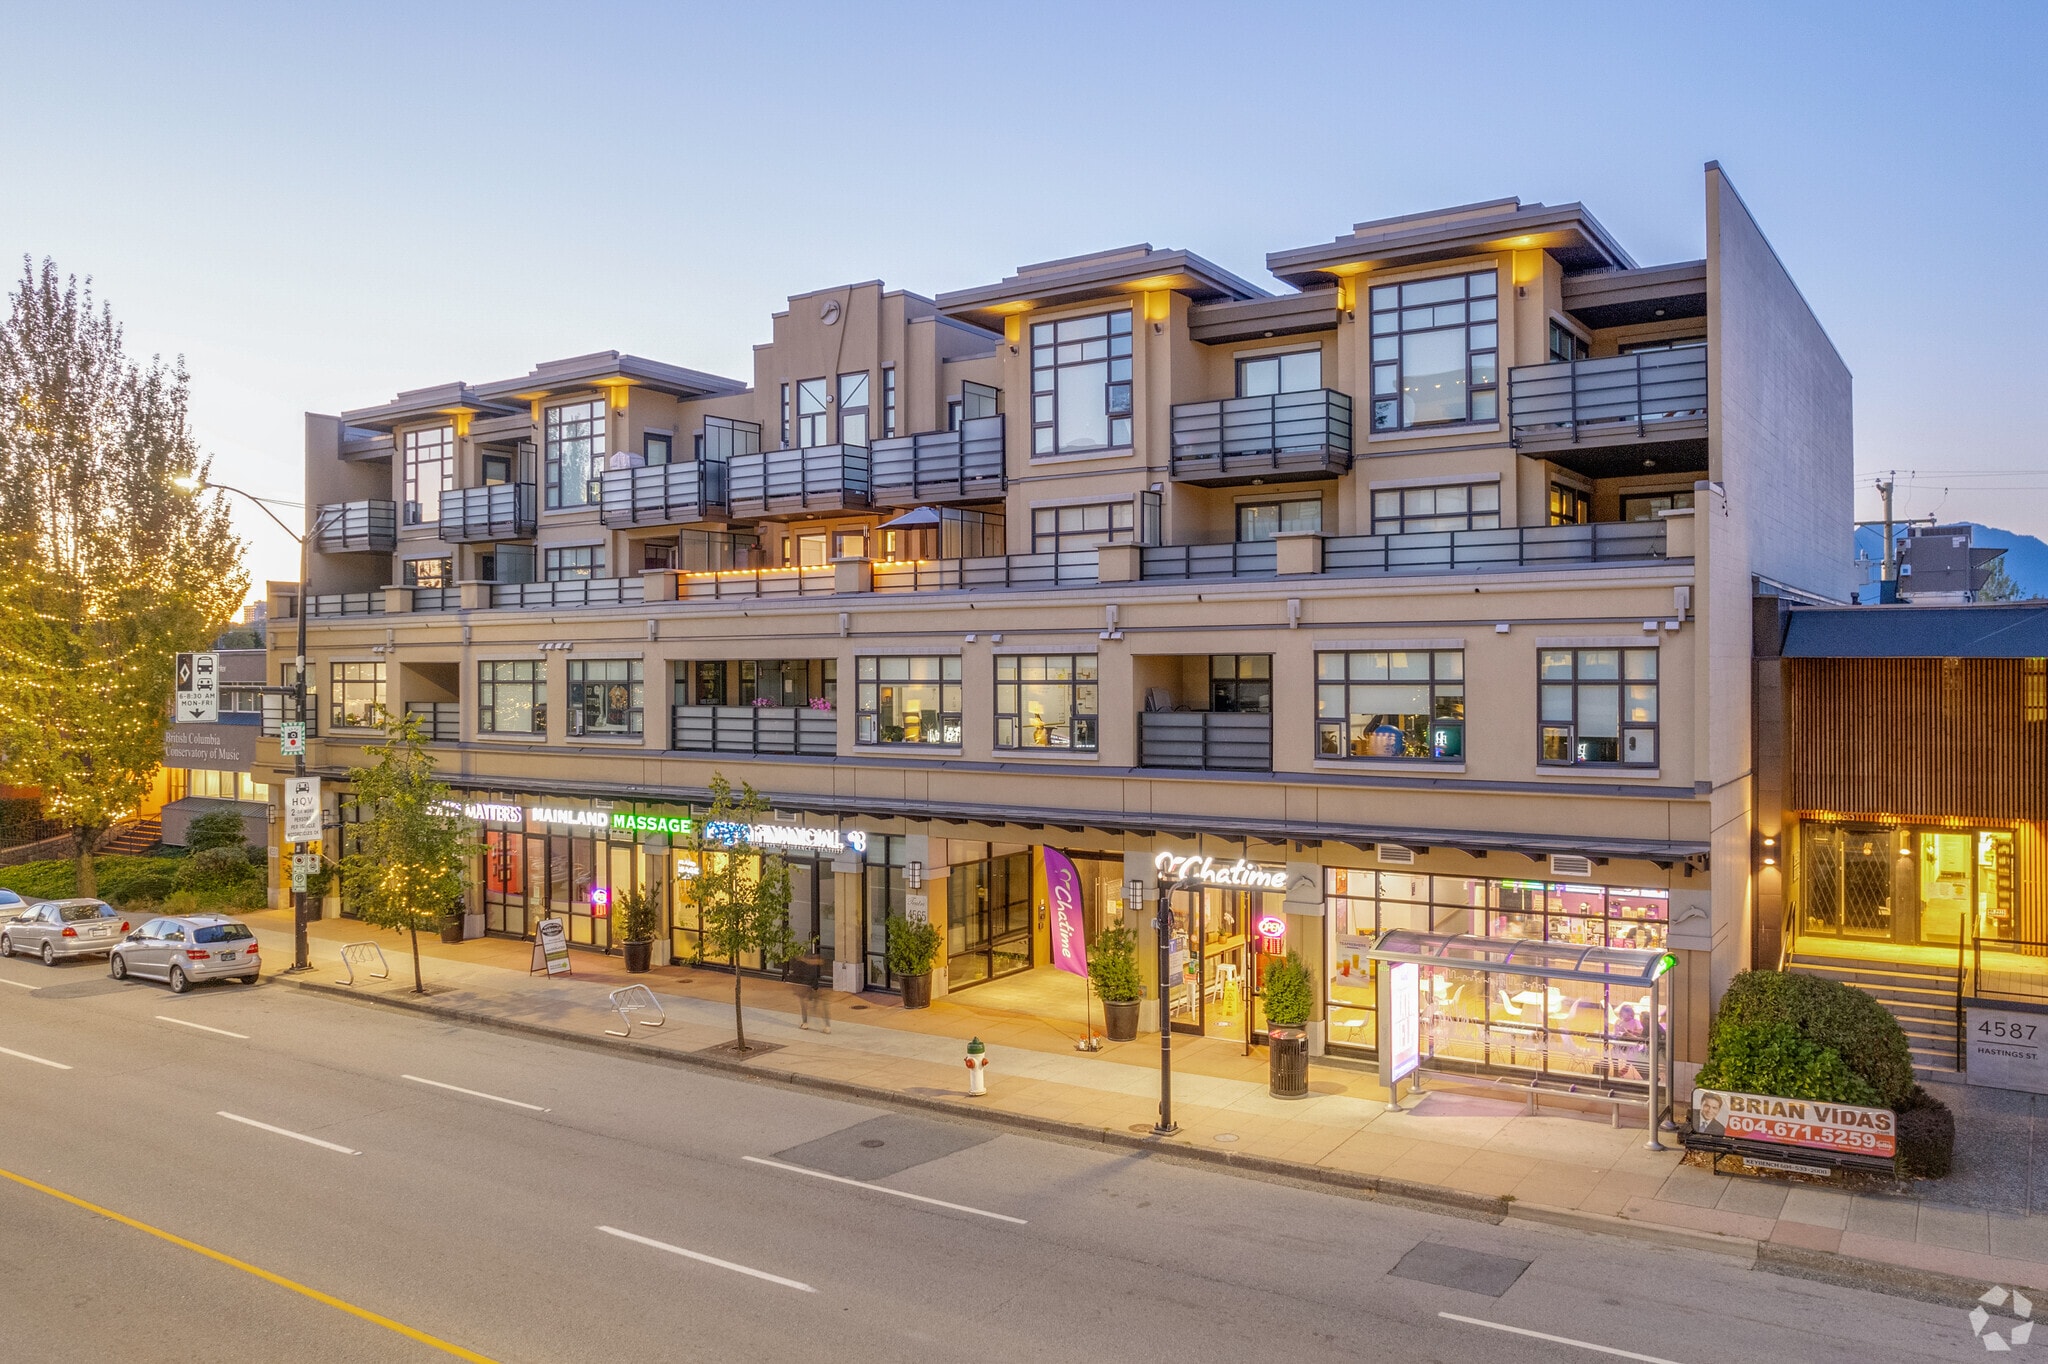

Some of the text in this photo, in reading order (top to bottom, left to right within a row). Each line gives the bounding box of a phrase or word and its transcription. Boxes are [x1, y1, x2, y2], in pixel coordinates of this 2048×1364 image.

[165, 731, 221, 745] British Columbia
[165, 746, 240, 761] Conservatory of Music
[292, 797, 313, 806] HOV
[291, 809, 296, 817] 2
[532, 807, 608, 827] MAINLAND
[613, 813, 692, 834] MASSAGE
[1179, 855, 1287, 888] Chatime
[907, 909, 927, 922] 4565
[1054, 885, 1075, 959] Chatime
[1262, 922, 1282, 933] OPEN
[1978, 1020, 2037, 1040] 4587
[1977, 1047, 2024, 1059] HASTINGS
[1729, 1095, 1891, 1130] BRIAN VIDAS
[1729, 1117, 1876, 1148] 604.671.5259
